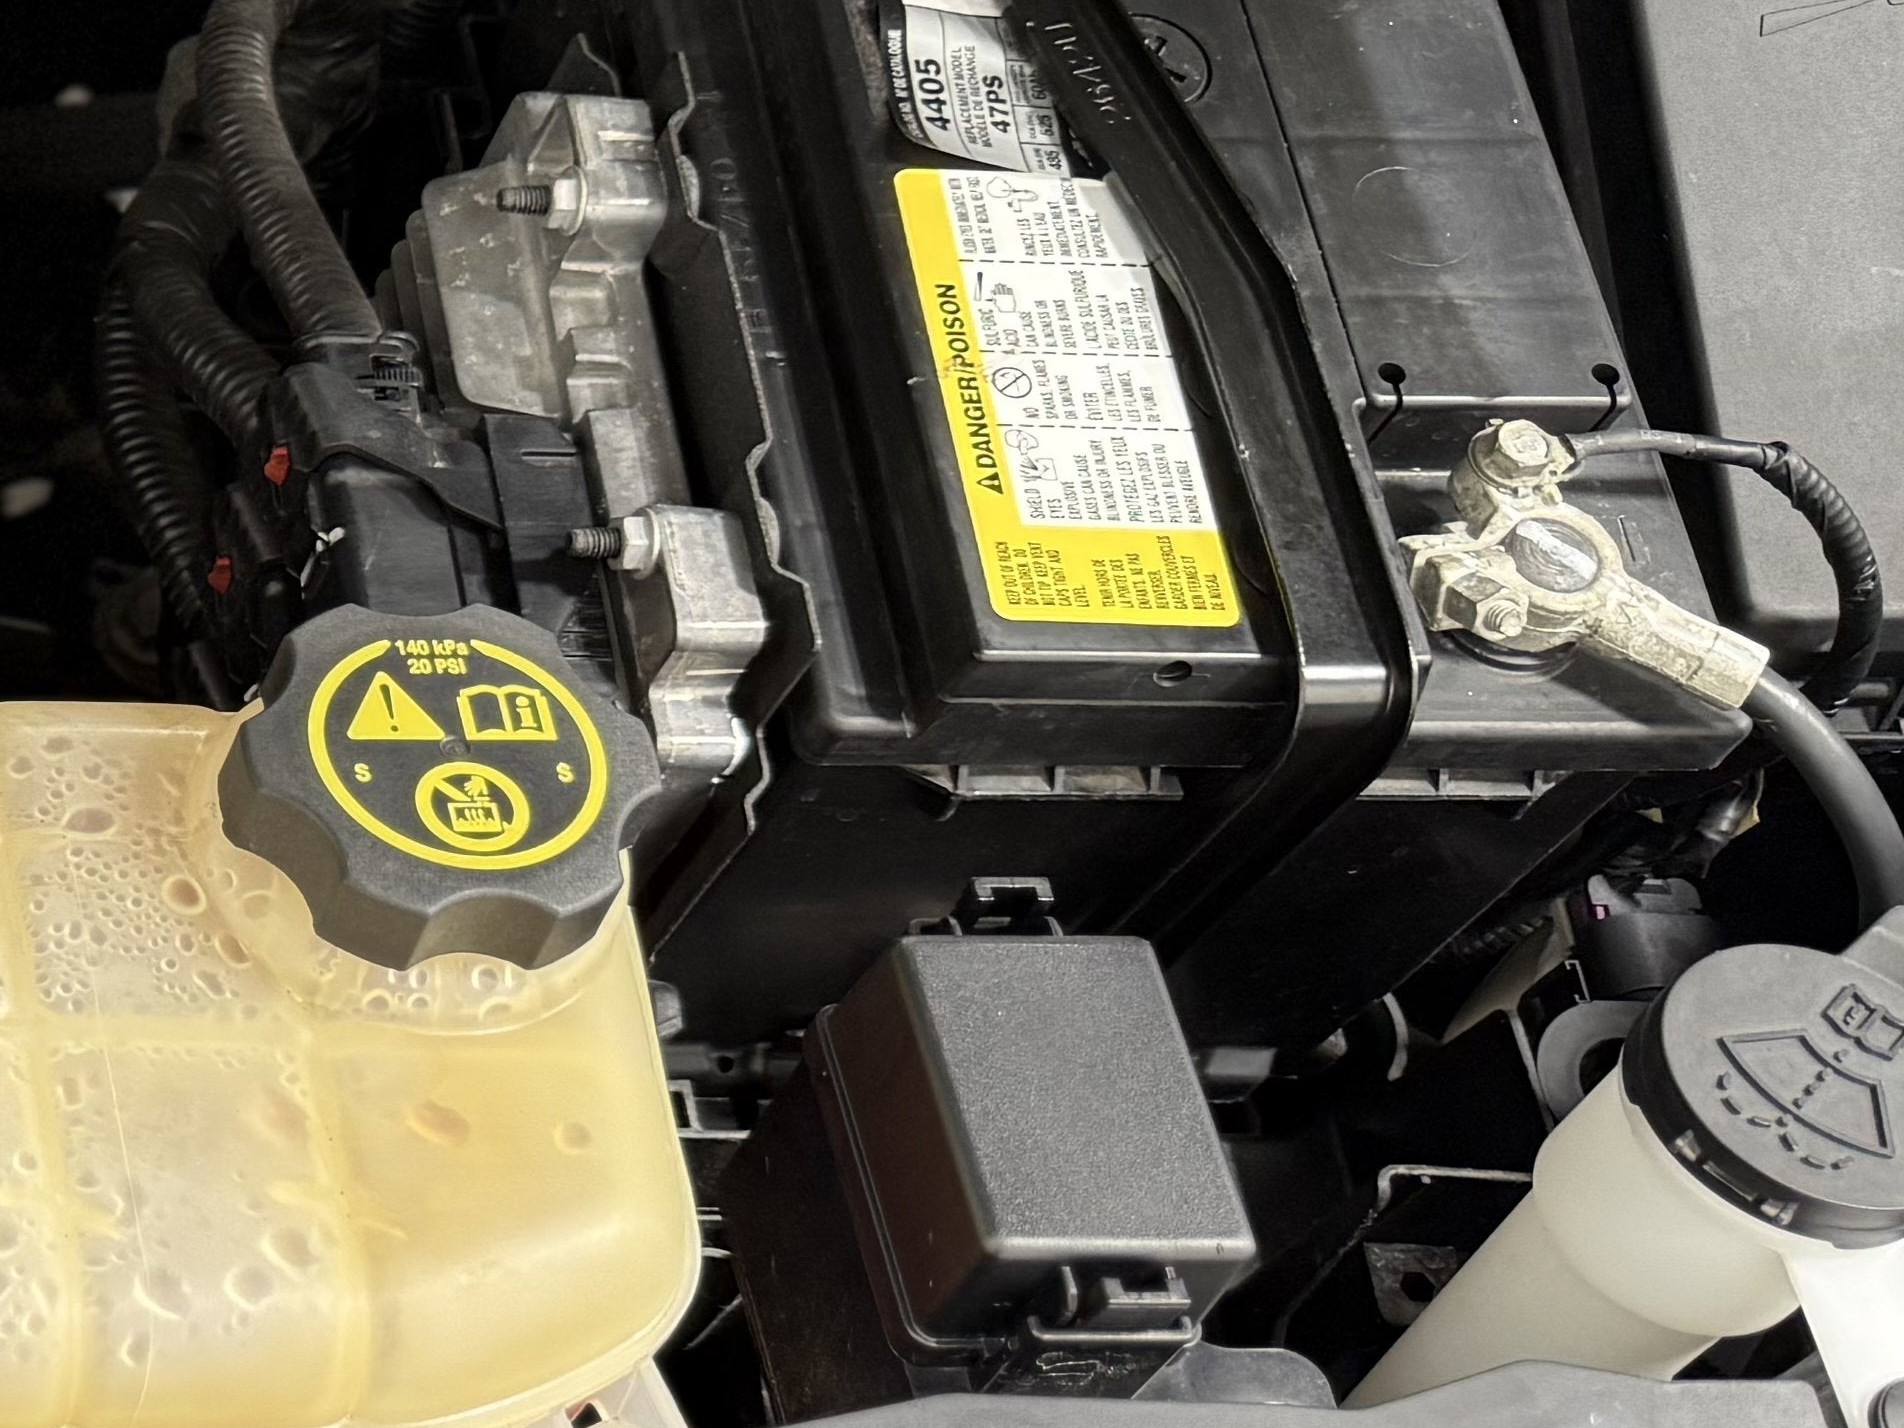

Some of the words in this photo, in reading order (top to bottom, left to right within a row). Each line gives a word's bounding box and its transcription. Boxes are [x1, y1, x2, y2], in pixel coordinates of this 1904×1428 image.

[887, 30, 904, 76] CATALOGUE
[951, 47, 964, 80] MODEL
[964, 46, 981, 97] RECHANGE
[914, 59, 950, 131] 4405
[972, 100, 983, 110] DE
[982, 75, 1010, 133] 47PS
[953, 82, 978, 144] REPLACEMENT
[1016, 219, 1031, 230] LES
[934, 284, 997, 468] DANGER/POISON
[1022, 408, 1039, 418] NO
[1107, 410, 1122, 421] LES
[1126, 410, 1141, 422] LES
[1115, 461, 1133, 475] LES
[1024, 489, 1045, 519] SHIELD
[1046, 499, 1064, 518] EYES
[1060, 481, 1082, 520] EXPLOSIVE
[1149, 510, 1164, 522] LES
[1033, 561, 1048, 576] KEEP
[1001, 575, 1017, 587] OUT
[1006, 590, 1021, 604] KEEP
[395, 639, 430, 656] 140
[432, 639, 469, 656] kPa
[407, 658, 429, 674] 20
[435, 658, 467, 675] PSI
